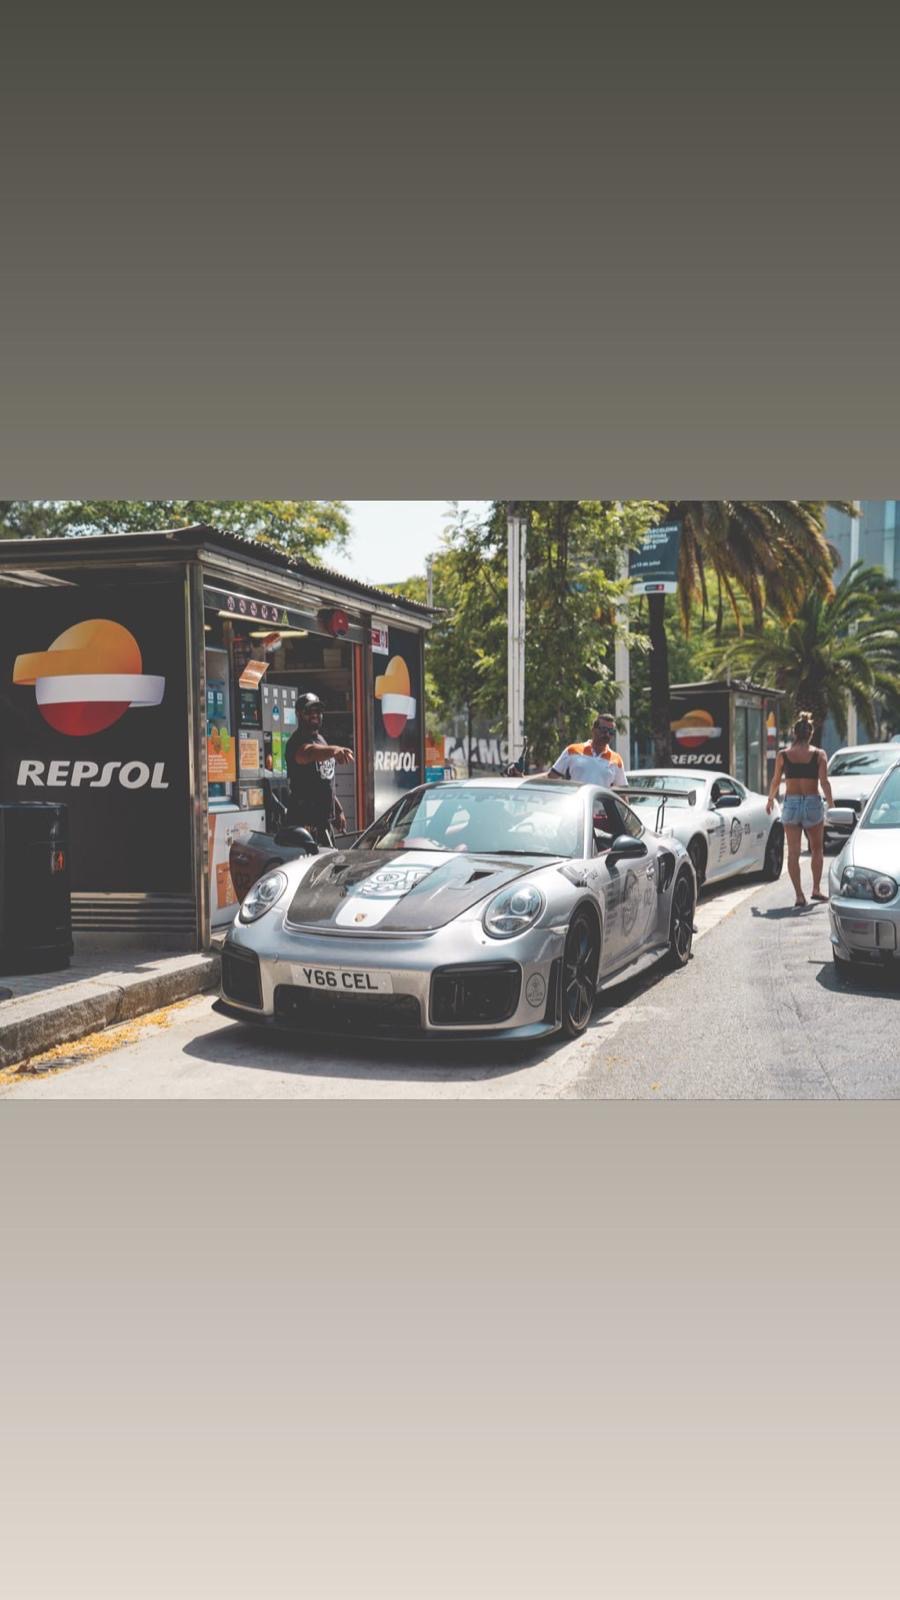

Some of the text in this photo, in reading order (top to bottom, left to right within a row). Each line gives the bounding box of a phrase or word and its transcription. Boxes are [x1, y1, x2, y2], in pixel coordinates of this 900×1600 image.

[374, 750, 418, 773] REPSOL
[671, 753, 723, 765] REPSOL
[16, 759, 169, 790] REPSOL
[302, 967, 379, 990] Y66 CEL
